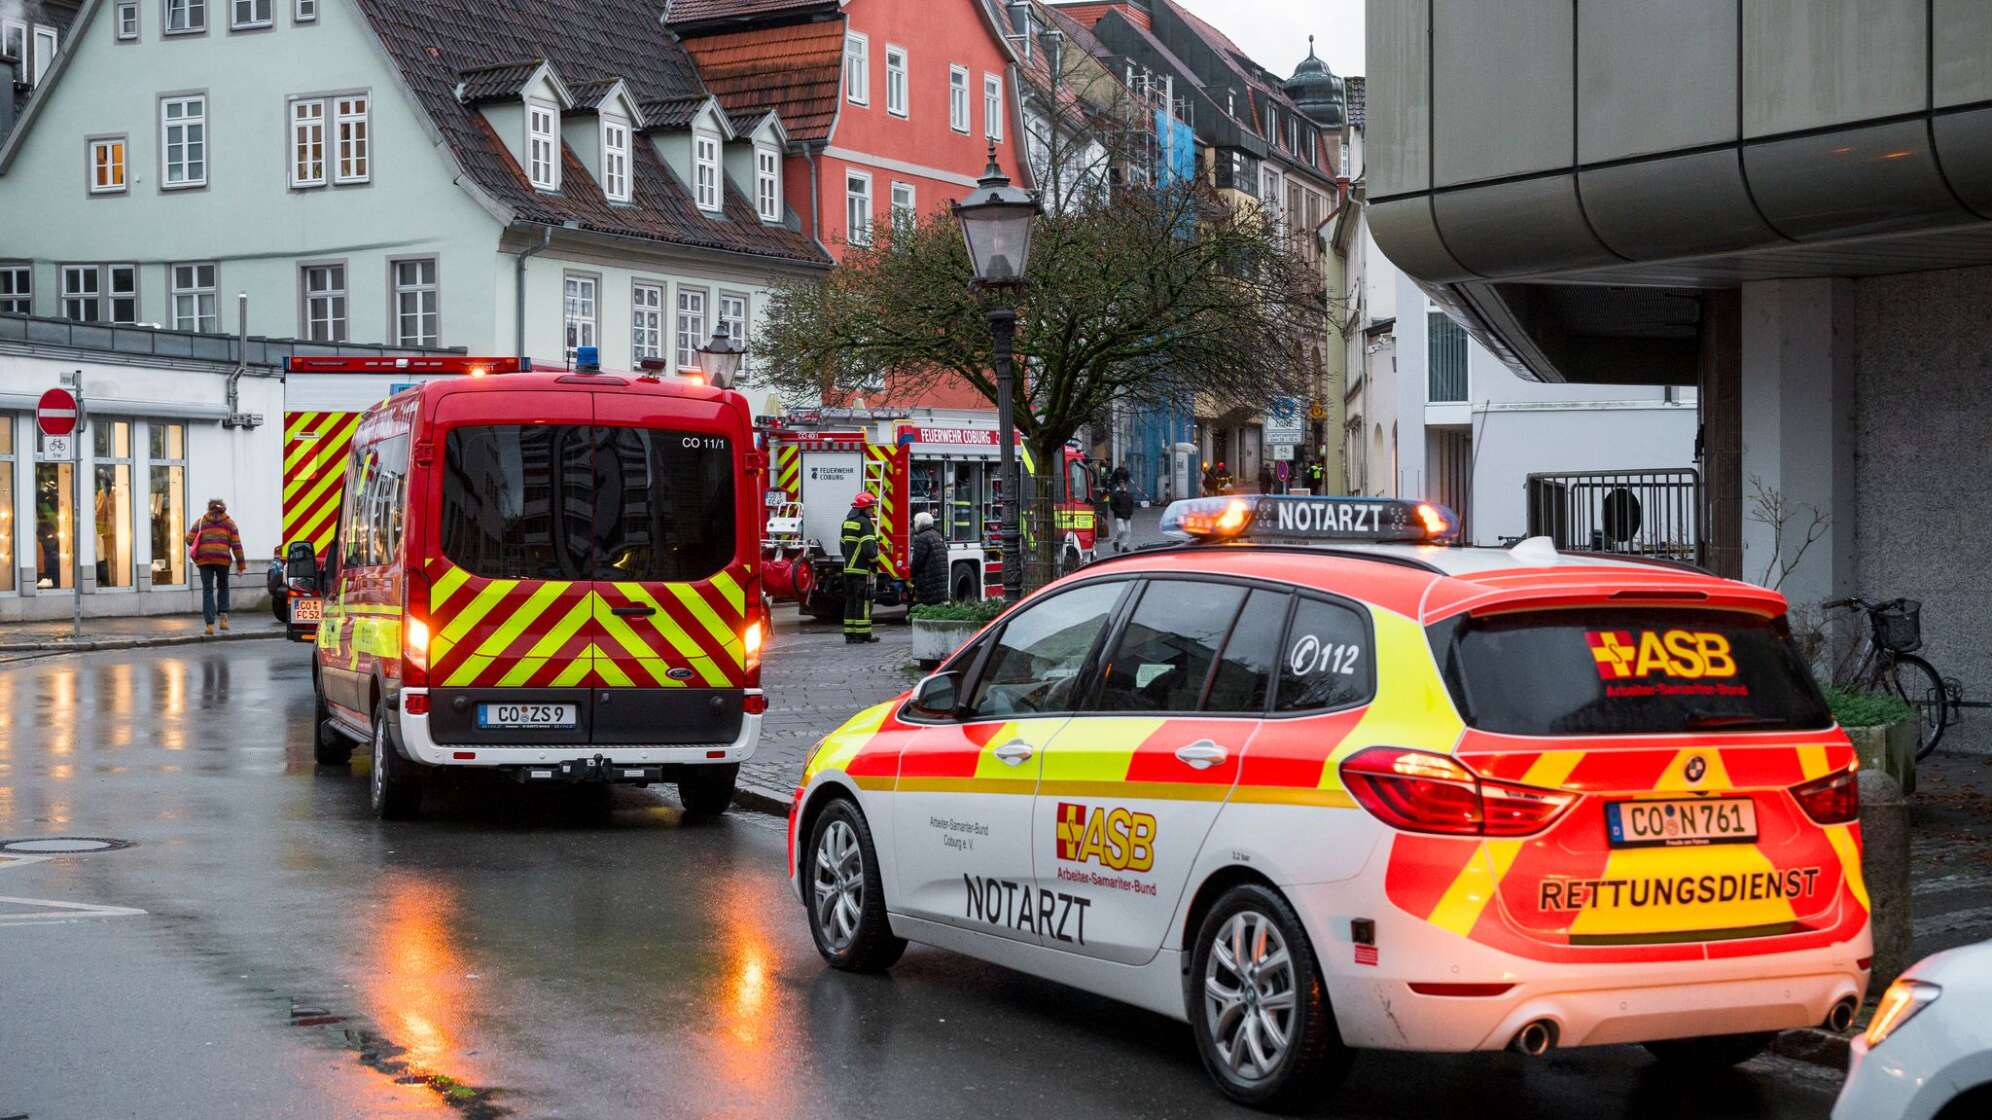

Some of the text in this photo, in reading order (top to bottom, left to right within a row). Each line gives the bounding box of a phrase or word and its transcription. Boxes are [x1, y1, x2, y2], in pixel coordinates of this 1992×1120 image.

[682, 438, 725, 449] CO 11/1
[920, 428, 991, 444] FEUERWEHR COBURG
[1278, 502, 1384, 532] NOTARZT
[297, 610, 320, 619] FC 52
[300, 601, 311, 610] CO
[1319, 643, 1360, 675] 112
[1635, 629, 1738, 679] ASB
[498, 706, 564, 722] CO ZS 9
[929, 815, 990, 837] Arbeiter-Samariter-Bund
[1631, 806, 1663, 836] CO
[1680, 805, 1697, 835] N
[1701, 803, 1745, 833] 761
[943, 833, 962, 852] Coburg
[1078, 806, 1158, 874] ASB
[1056, 867, 1157, 897] Arbeiter-Samariter-Bund
[1540, 870, 1819, 910] RETTUNGSDIENST
[963, 872, 1092, 947] NOTARZT
